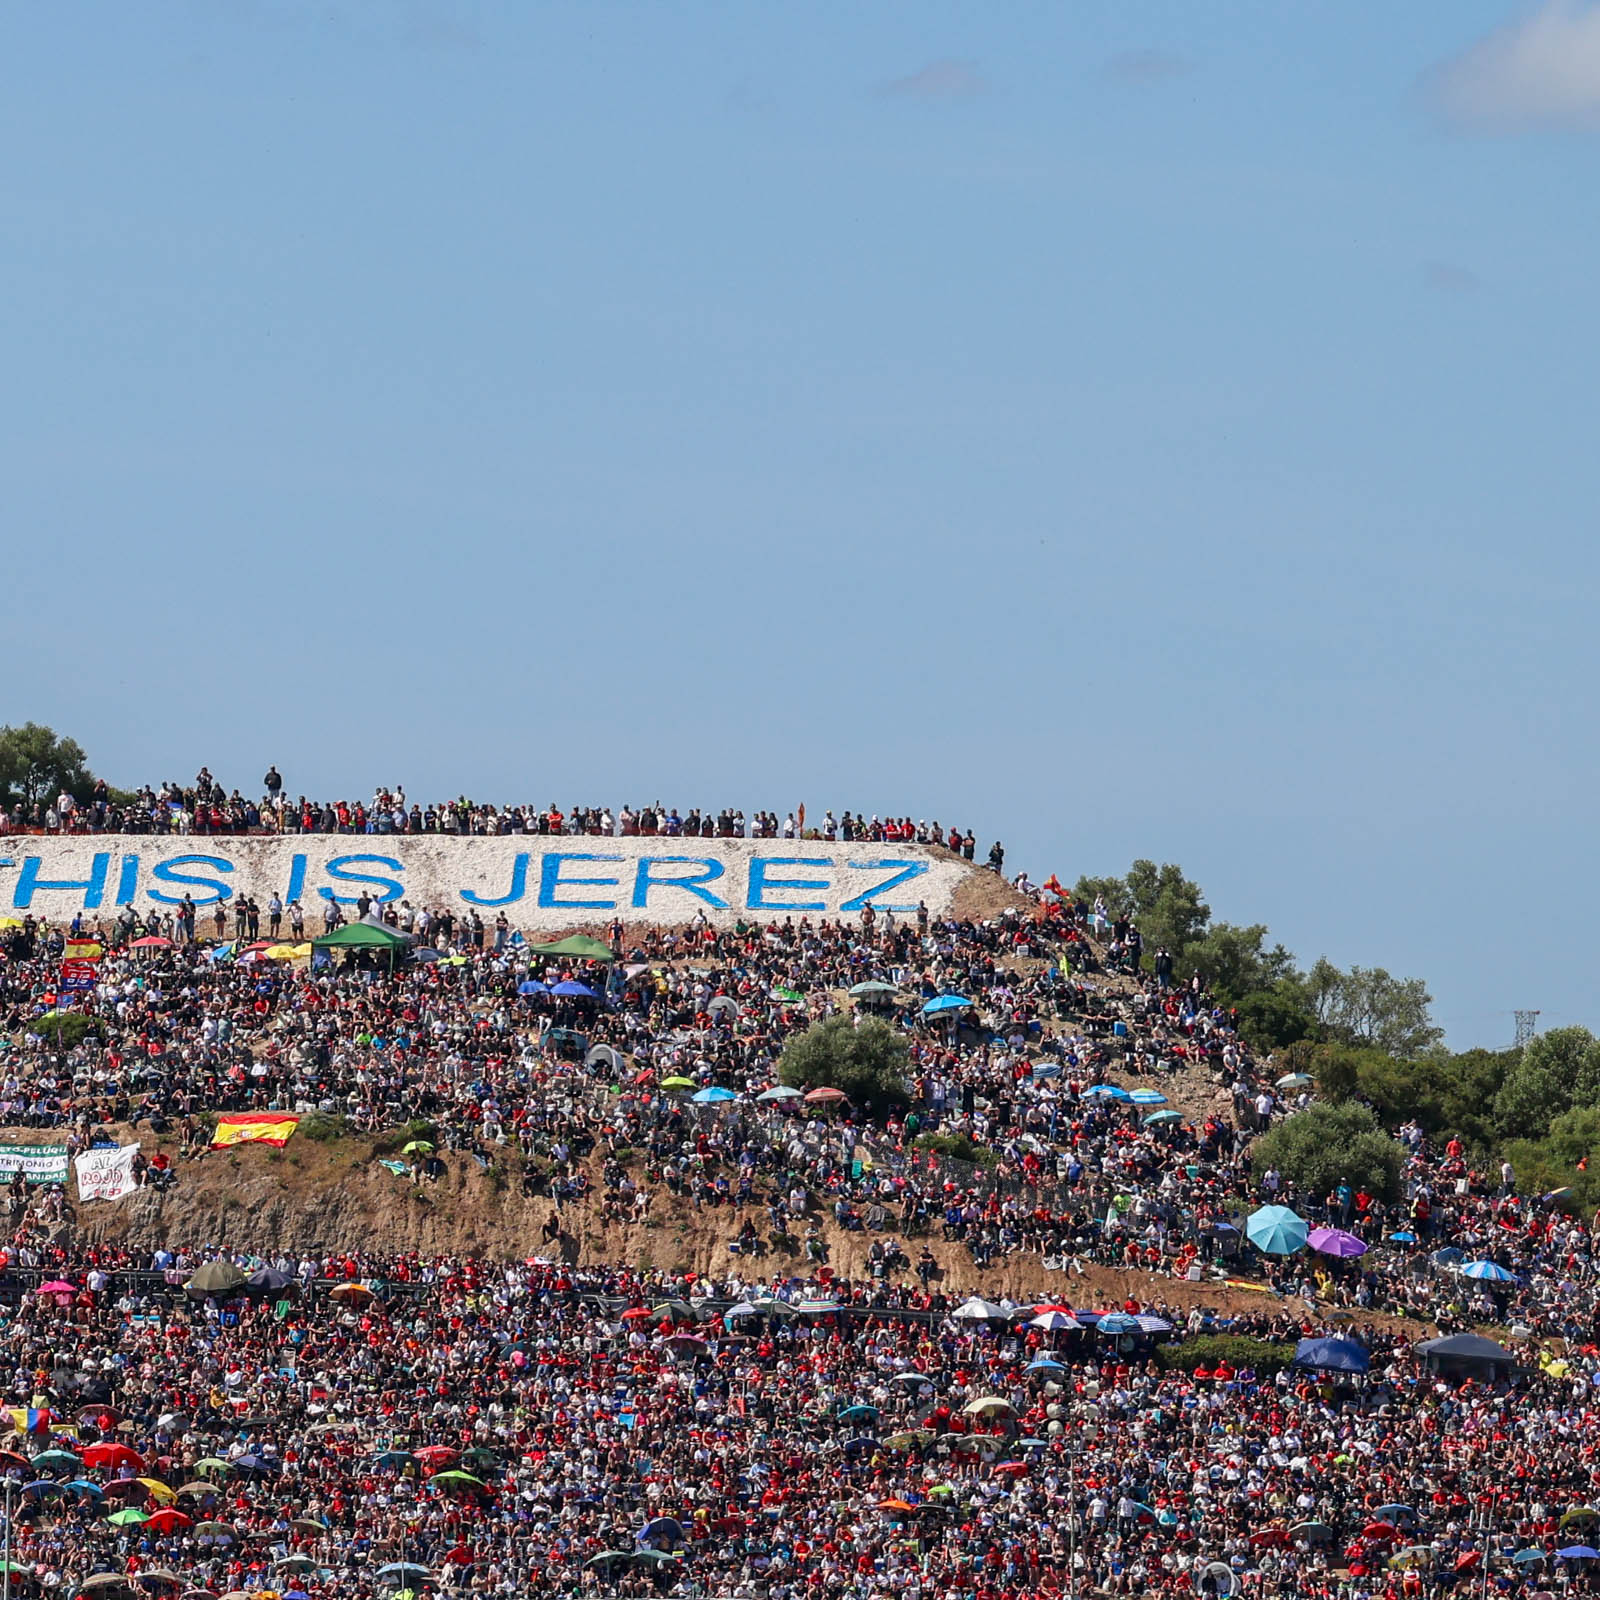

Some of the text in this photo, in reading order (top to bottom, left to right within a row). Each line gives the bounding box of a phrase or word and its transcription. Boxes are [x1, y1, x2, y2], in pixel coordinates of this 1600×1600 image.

[286, 853, 406, 907] IS
[459, 852, 932, 912] JEREZ
[81, 1169, 123, 1186] ROJO
